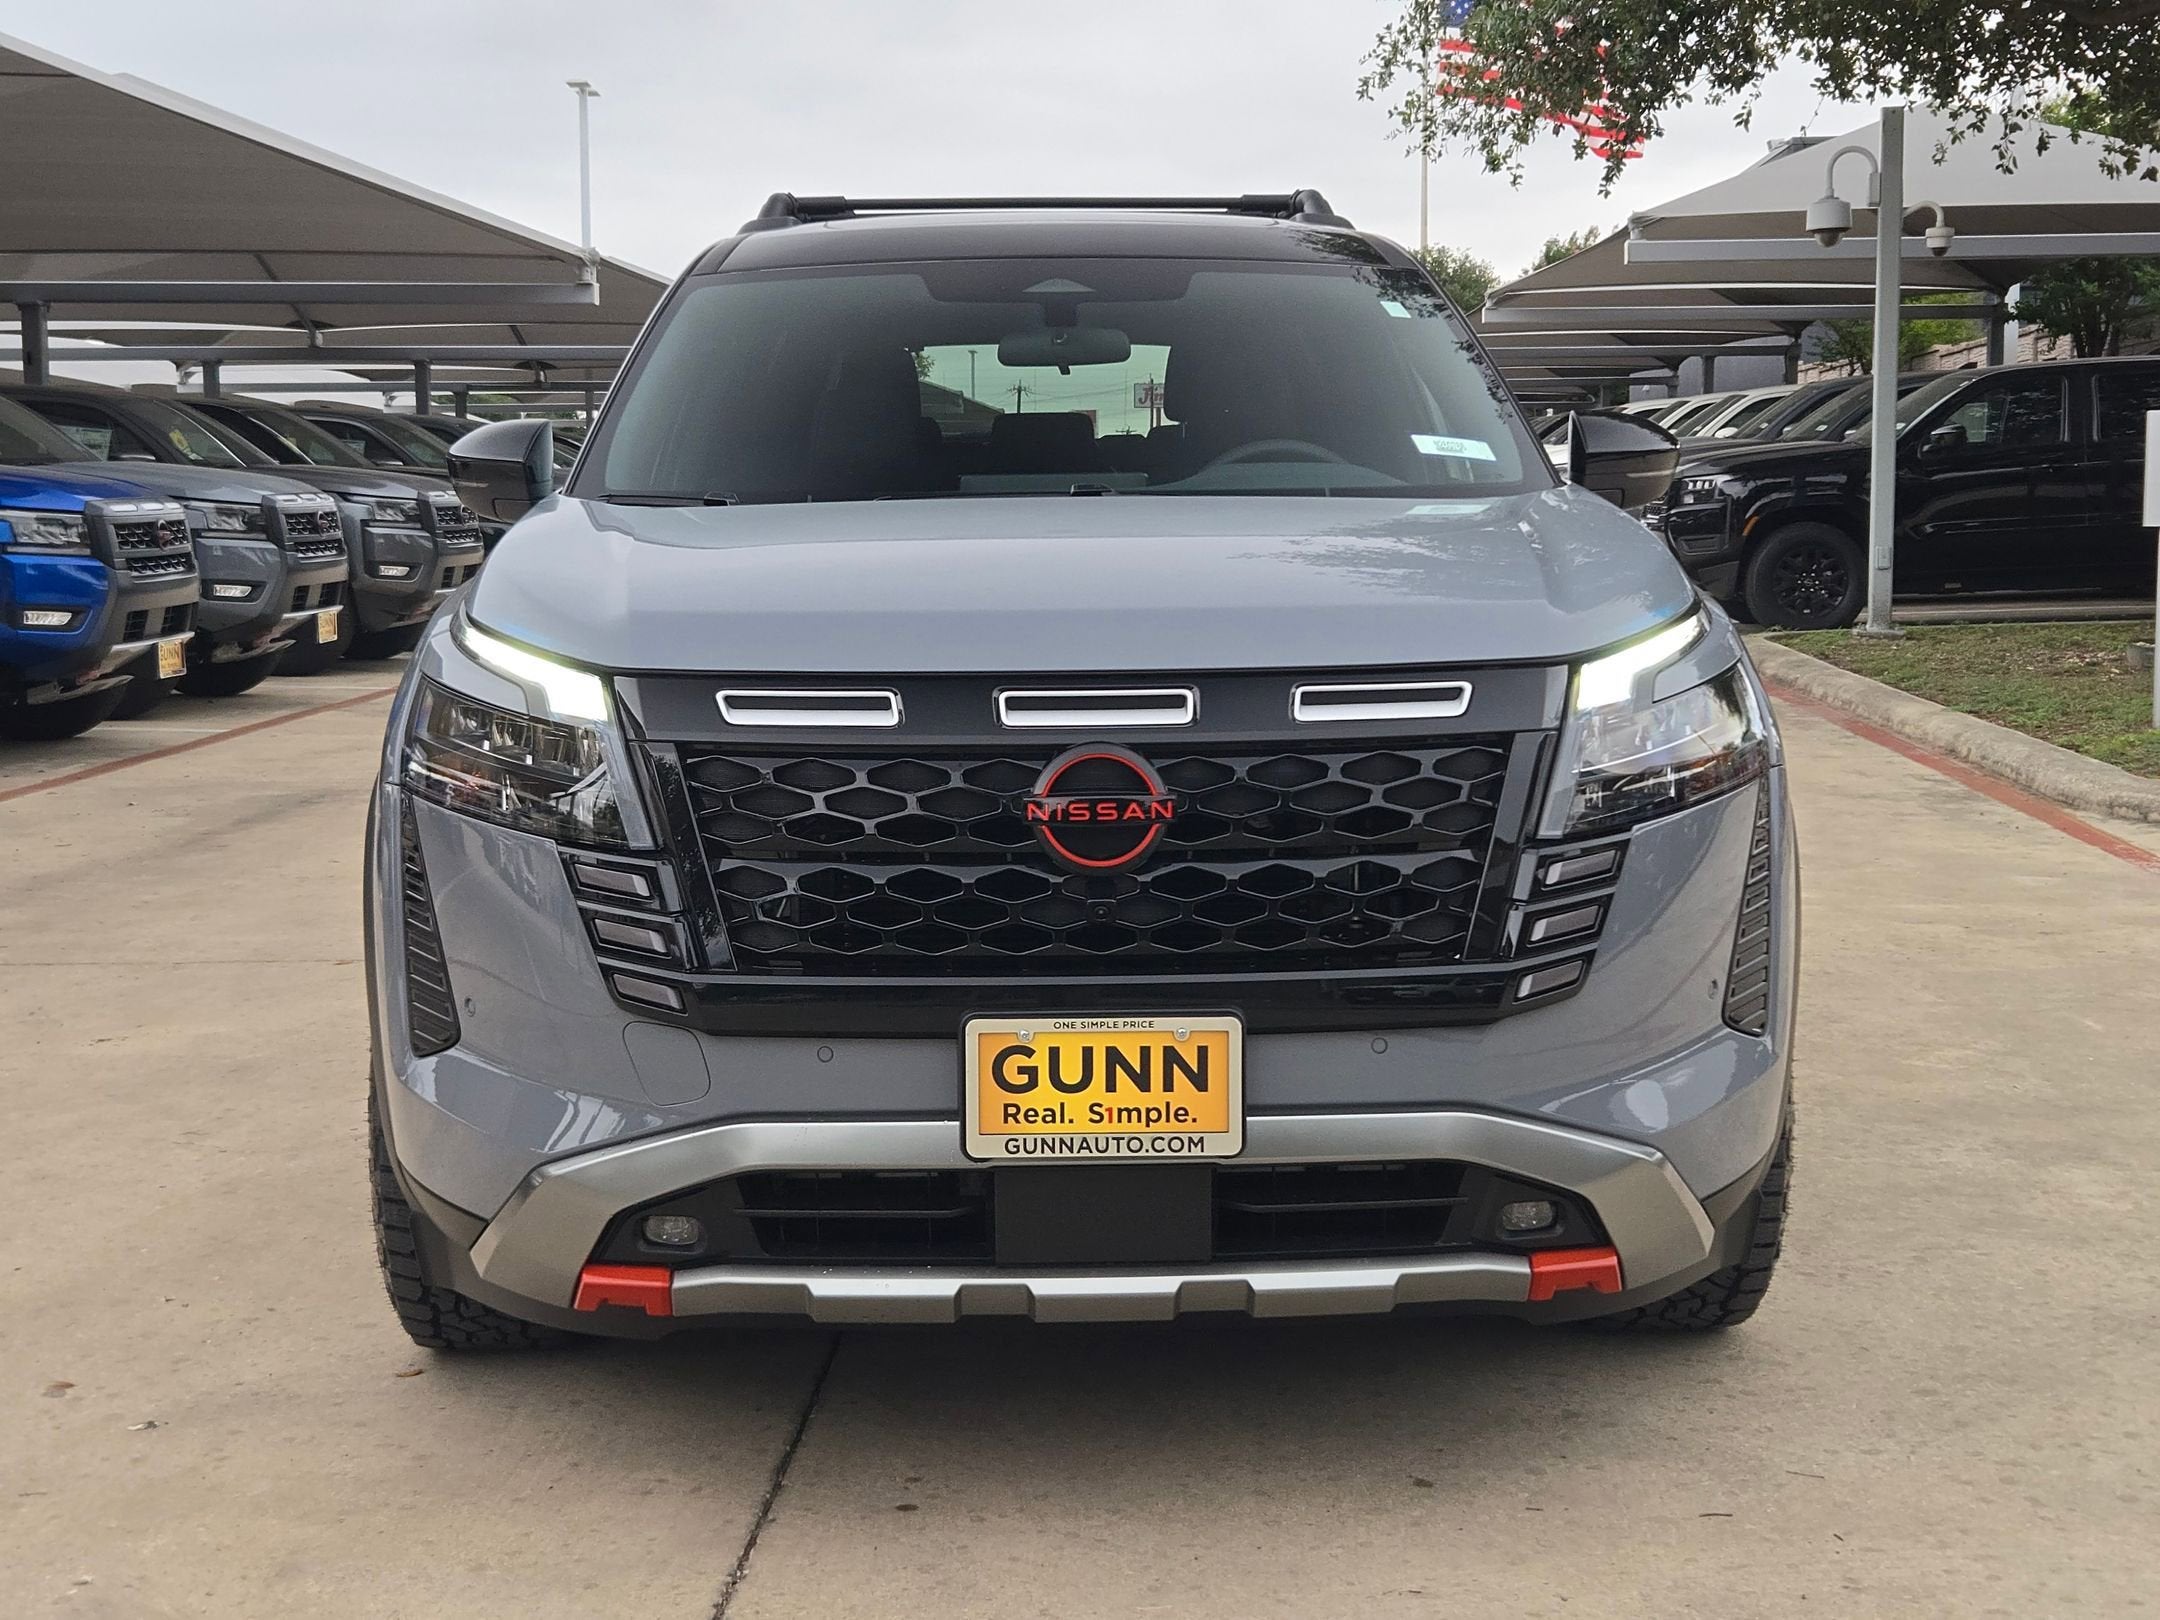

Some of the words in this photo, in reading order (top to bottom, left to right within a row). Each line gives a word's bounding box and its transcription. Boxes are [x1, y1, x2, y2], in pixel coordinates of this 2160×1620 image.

[1026, 801, 1174, 821] NISSAN
[1053, 1021, 1077, 1029] ONE
[1080, 1020, 1119, 1029] SIMPLE
[1122, 1020, 1155, 1029] PRICE
[991, 1044, 1209, 1095] GUNN
[1002, 1102, 1074, 1125] Real.
[1004, 1136, 1205, 1155] GUNNAUTO.COM
